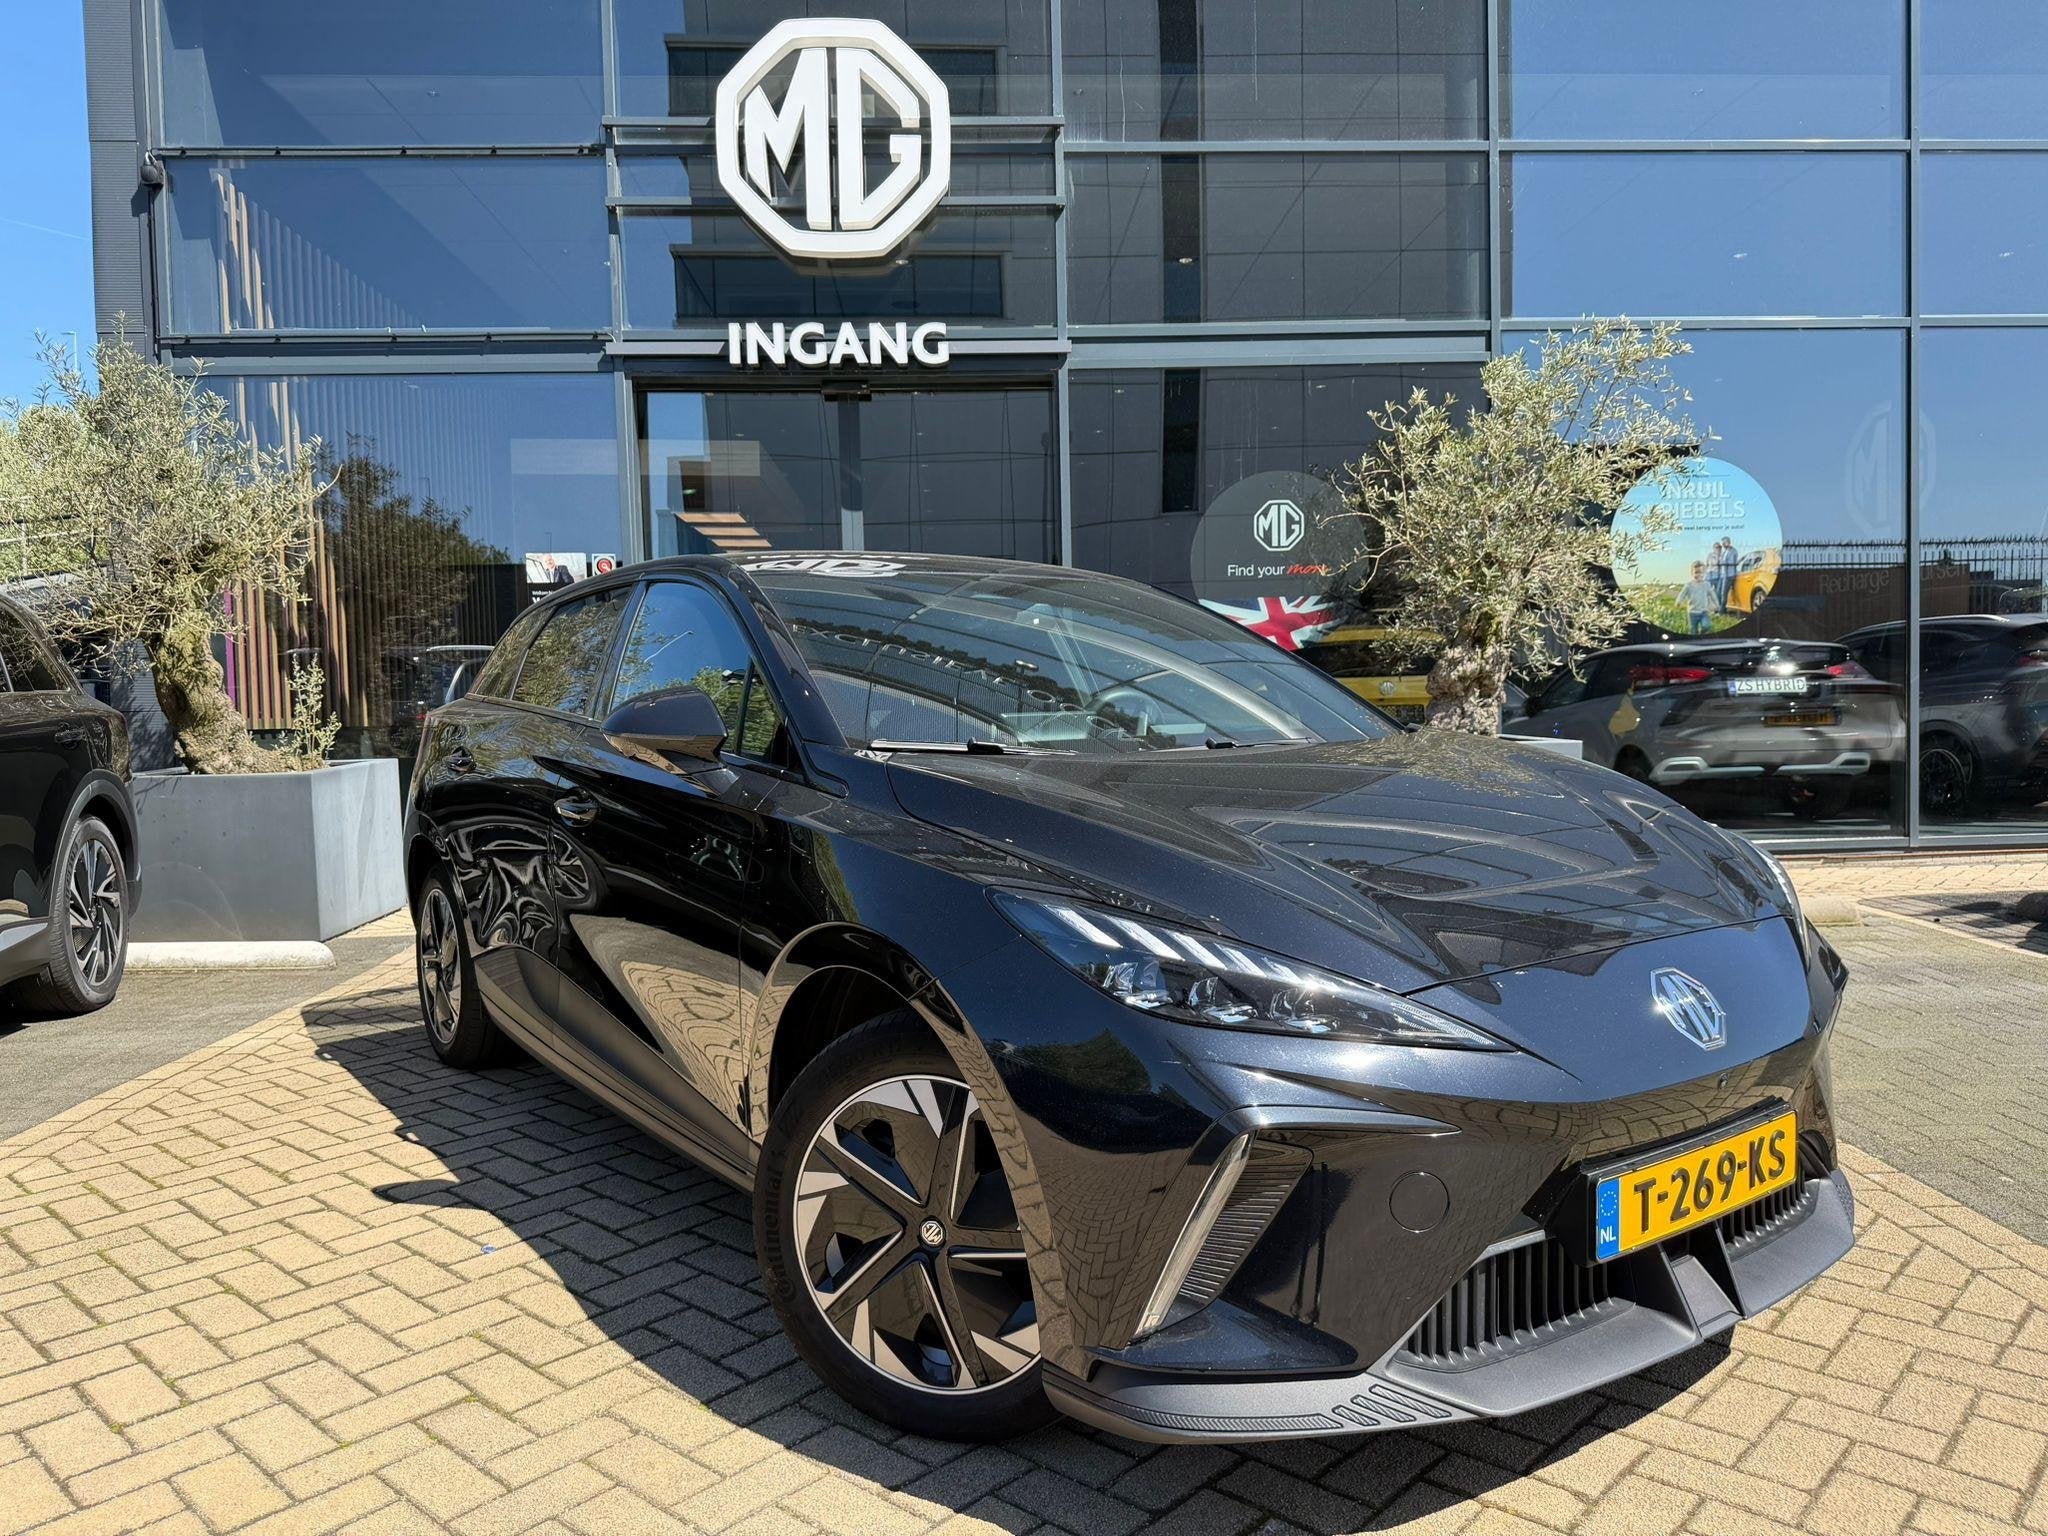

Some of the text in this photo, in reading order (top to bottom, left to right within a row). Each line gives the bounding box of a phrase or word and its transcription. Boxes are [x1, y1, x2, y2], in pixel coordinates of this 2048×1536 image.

[743, 46, 922, 232] MG
[727, 321, 950, 367] INGANG
[1664, 481, 1731, 499] NRUIL
[1256, 503, 1301, 548] MG
[1227, 564, 1254, 577] Find
[1257, 565, 1285, 578] your
[1737, 678, 1805, 691] ZS HYBRID
[1656, 972, 1721, 1043] MG
[1599, 1129, 1786, 1245] NL T-269-KS
